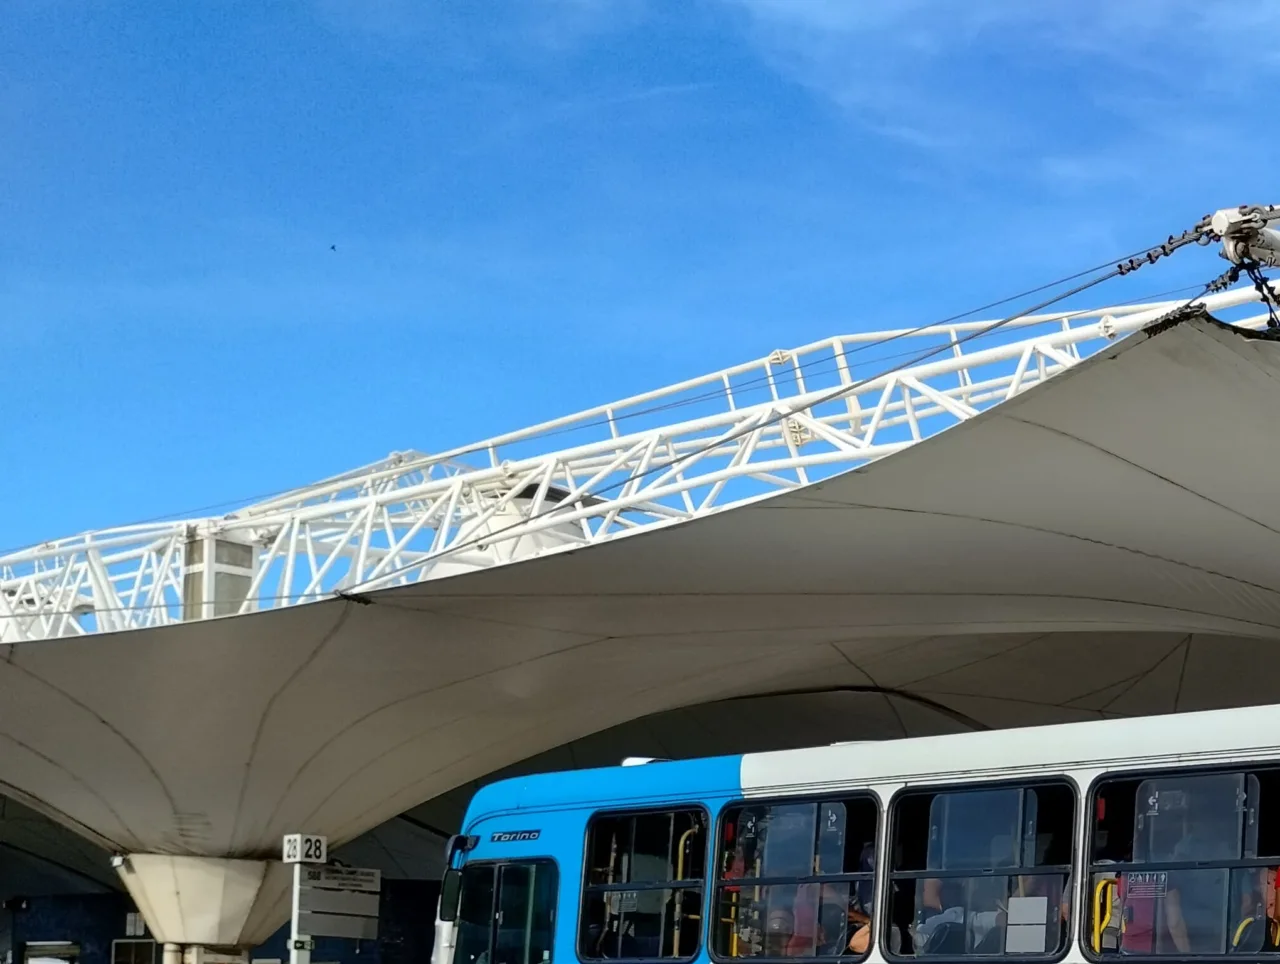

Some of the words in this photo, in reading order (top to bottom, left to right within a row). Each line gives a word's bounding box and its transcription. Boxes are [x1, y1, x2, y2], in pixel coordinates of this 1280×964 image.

[492, 831, 539, 841] Torino
[286, 838, 298, 859] 28
[304, 838, 322, 859] 28
